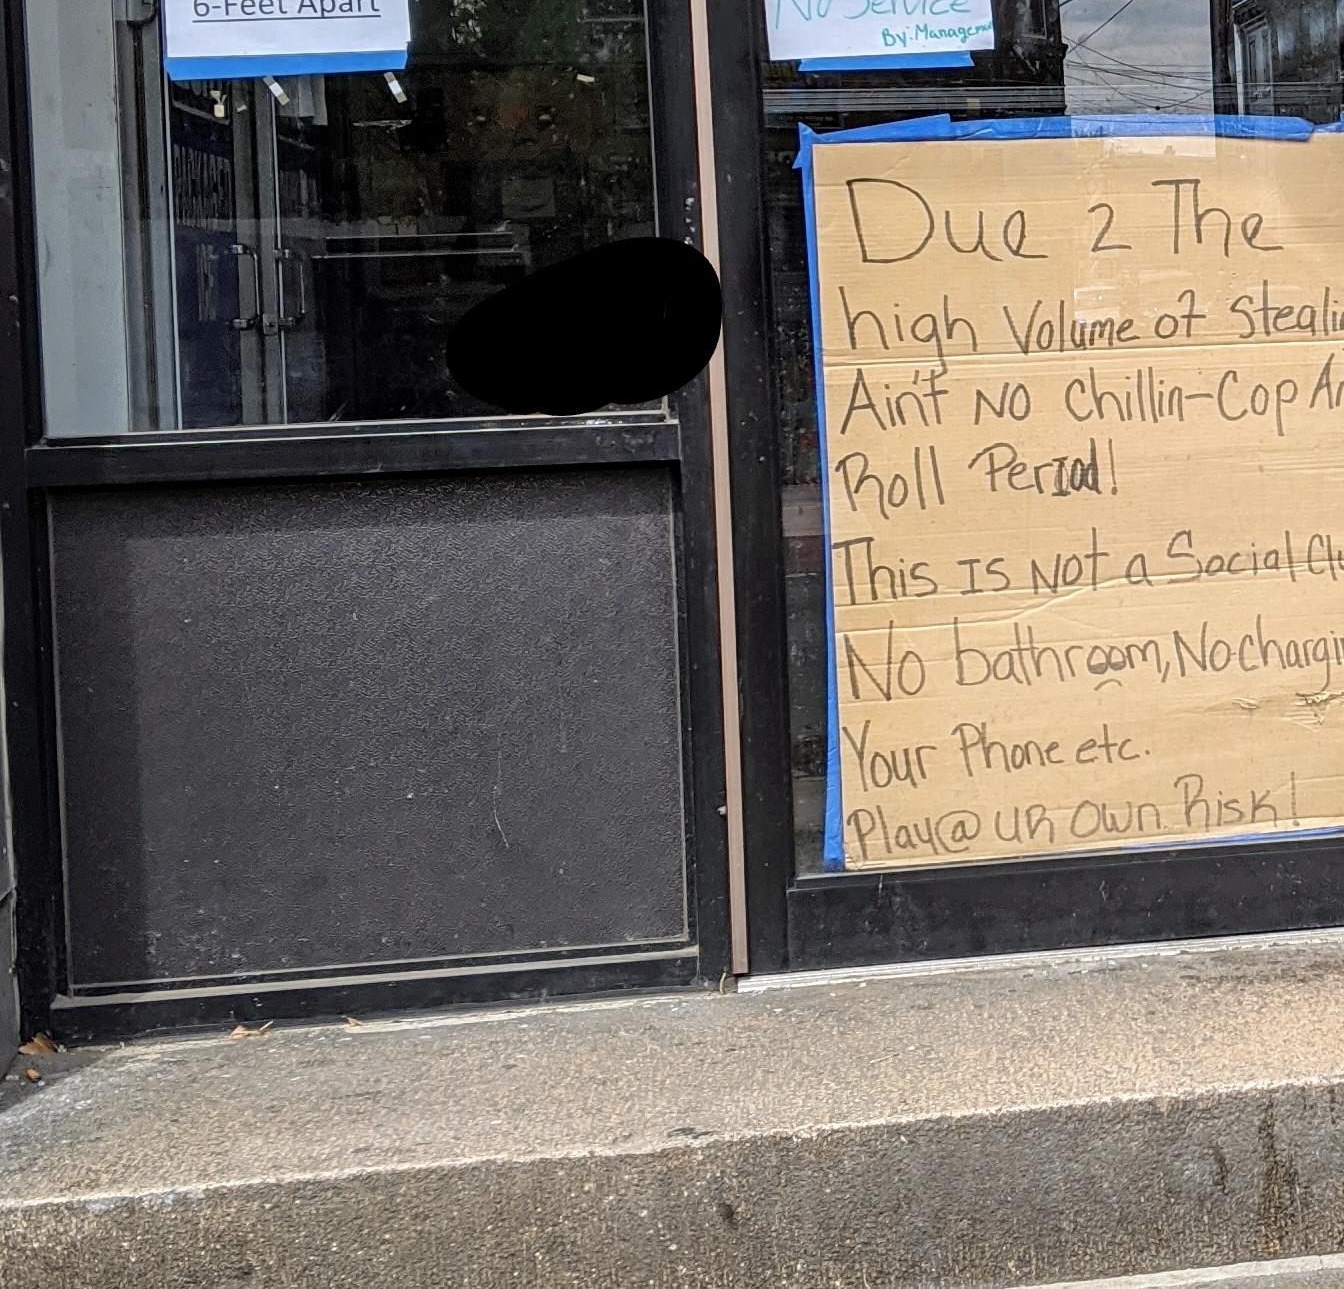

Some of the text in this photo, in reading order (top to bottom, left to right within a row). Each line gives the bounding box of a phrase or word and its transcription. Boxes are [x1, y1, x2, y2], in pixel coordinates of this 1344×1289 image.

[845, 176, 1285, 265] Due 2 The
[838, 285, 978, 376] high
[1003, 299, 1141, 356] Volume
[1154, 288, 1207, 340] of
[840, 366, 950, 436] Ain't
[834, 443, 945, 518] Roll
[832, 536, 939, 606] This
[1125, 551, 1155, 587] a
[1166, 529, 1297, 584] Social
[842, 620, 926, 702] No
[841, 718, 1152, 793] Your Phone etc.
